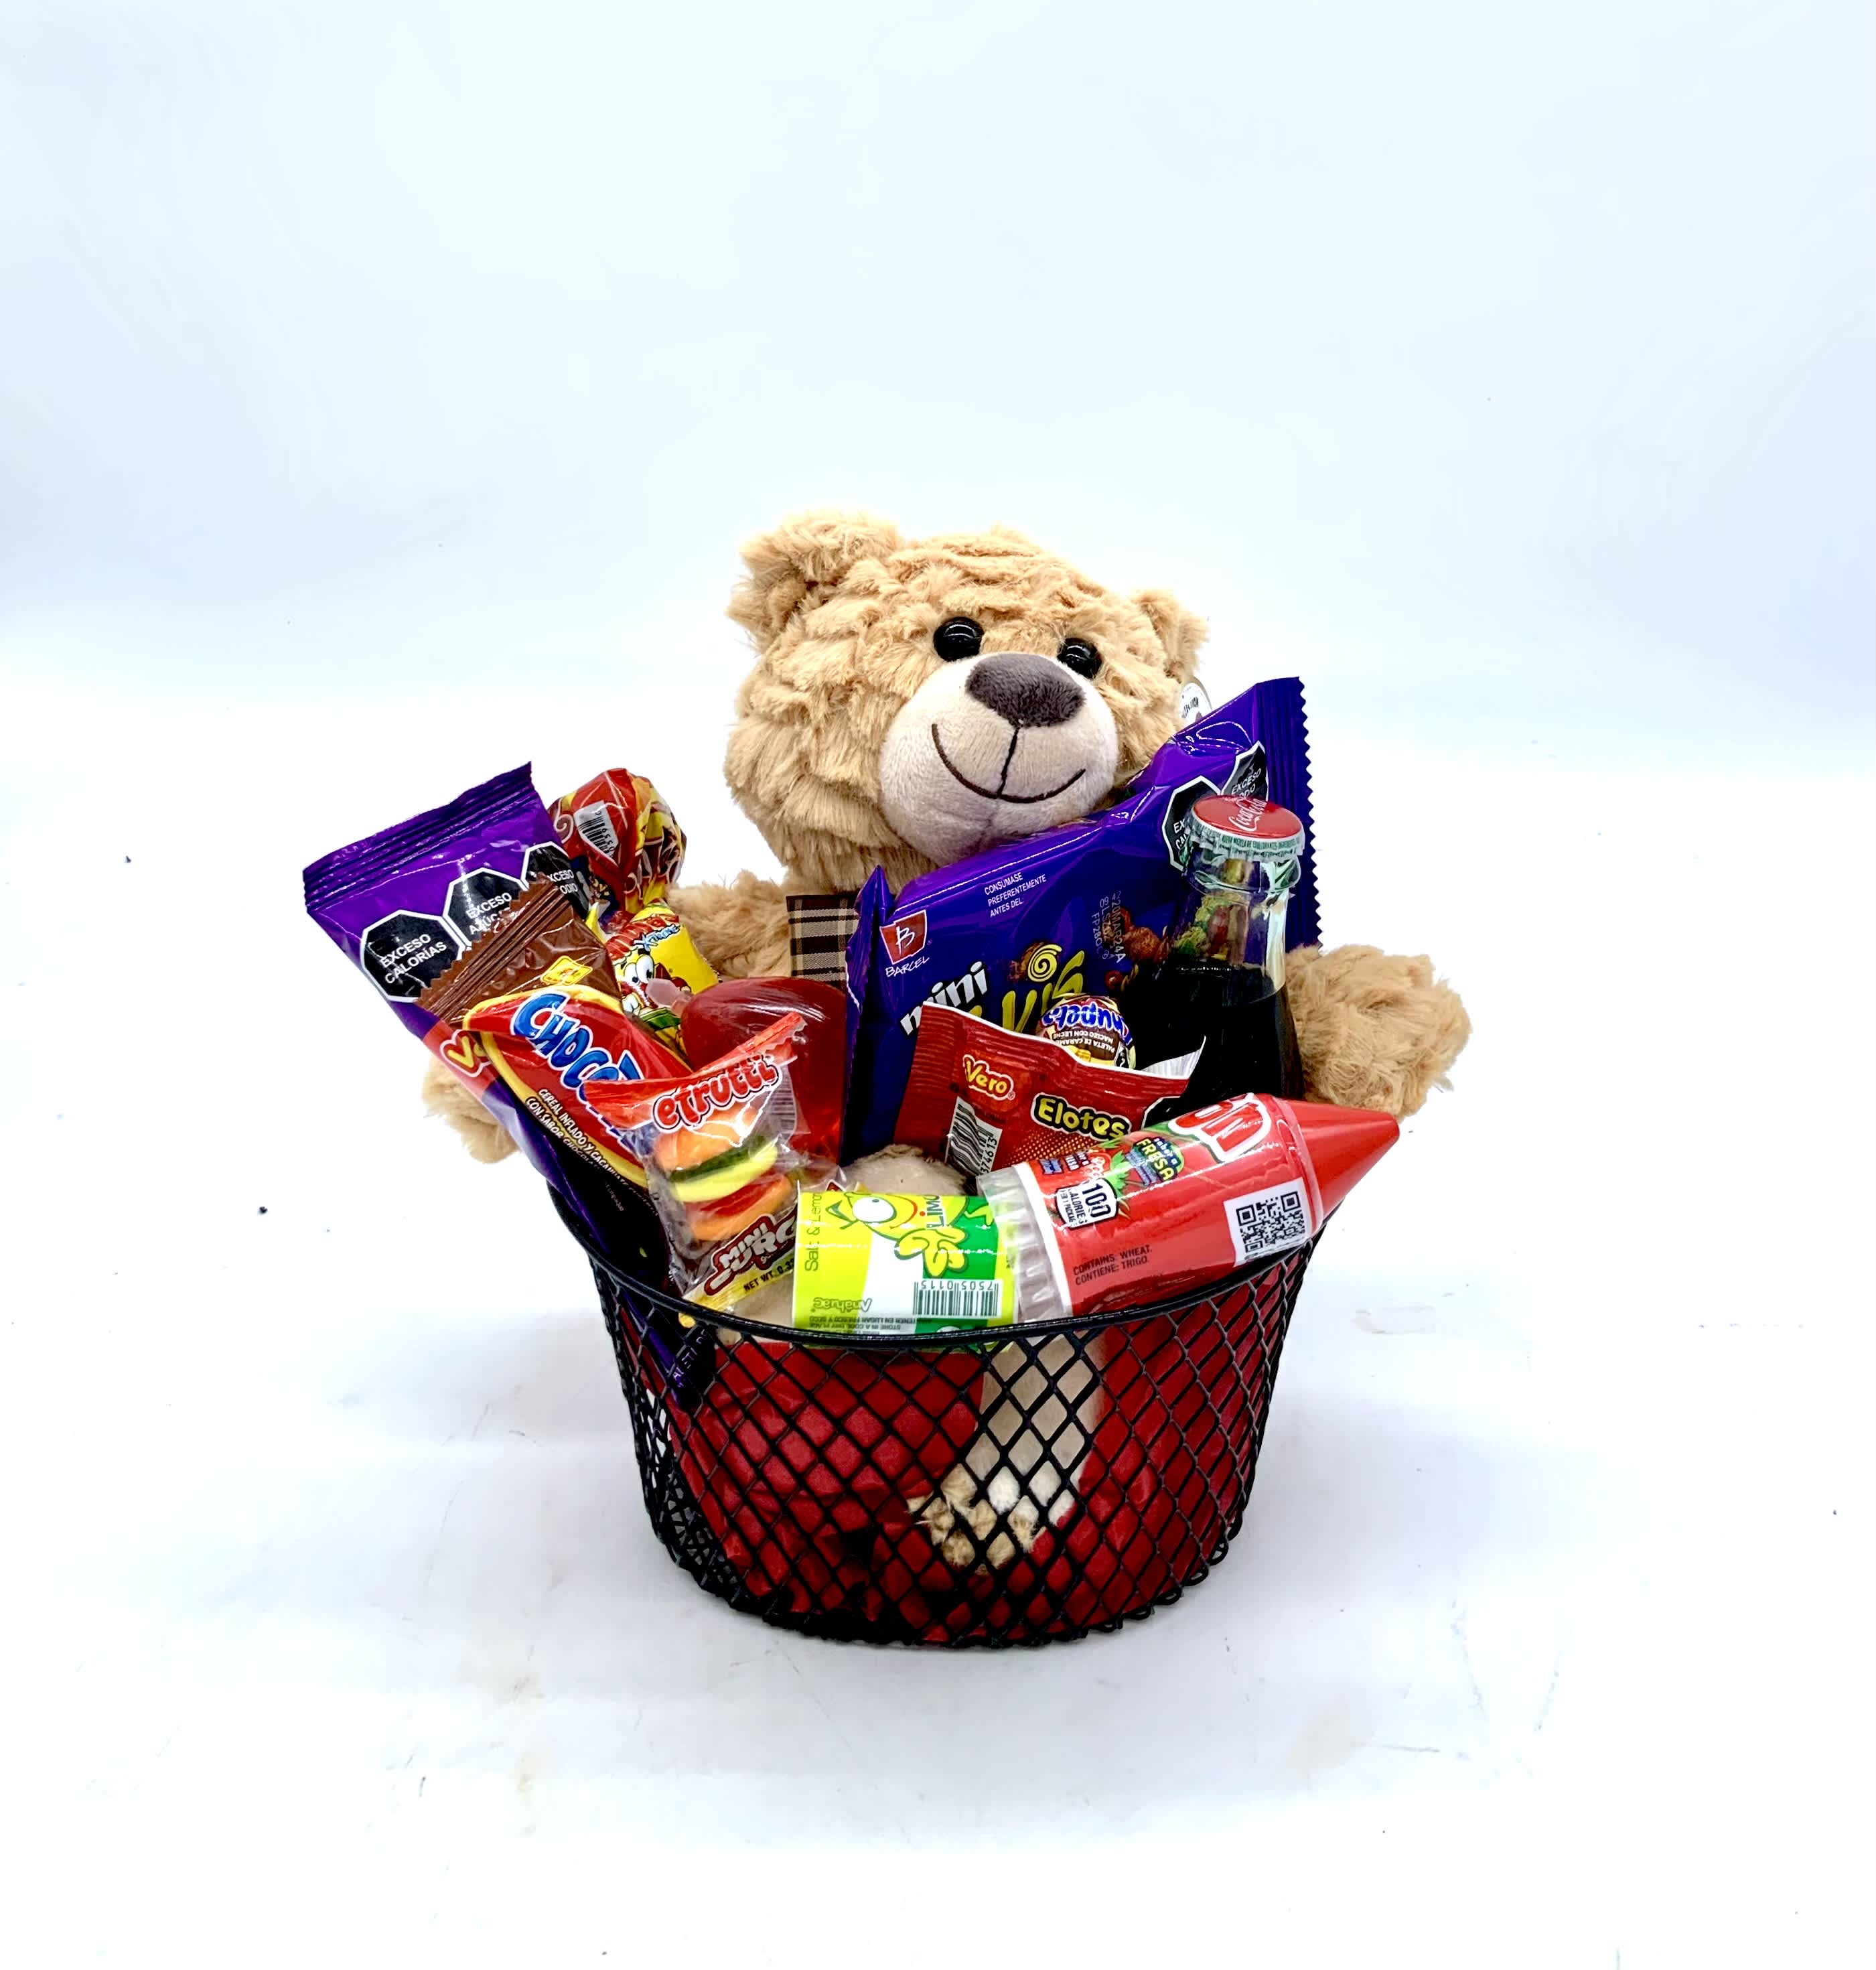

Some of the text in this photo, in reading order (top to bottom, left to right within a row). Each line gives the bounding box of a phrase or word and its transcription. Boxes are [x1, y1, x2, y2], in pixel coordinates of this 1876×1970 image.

[1231, 768, 1262, 794] EXCESO
[549, 868, 575, 883] XCESO
[984, 871, 1023, 896] CONSUMASE
[559, 882, 579, 896] ODIO
[987, 873, 1048, 906] PREFERENTEMENTE
[466, 892, 512, 920] EXCESO
[989, 904, 1010, 918] ANTES
[379, 933, 432, 969] EXCESO
[384, 940, 448, 985] CALORÍAS
[885, 955, 930, 978] BARCEL
[1092, 1039, 1115, 1054] PALETA
[965, 1058, 1008, 1095] Vero
[538, 1088, 564, 1117] CEREAL
[559, 1111, 587, 1147] INFLADO
[540, 1113, 565, 1139] SABOR
[1038, 1097, 1127, 1141] Elotes
[1137, 1137, 1175, 1181] FRESA
[1082, 1182, 1112, 1218] 100
[806, 1226, 820, 1236] &
[719, 1222, 769, 1269] MINI
[1119, 1244, 1153, 1260] WHEAT.
[743, 1277, 760, 1293] NET
[921, 1280, 994, 1291] 7505 0115
[1075, 1263, 1120, 1286] CONTIENE:
[812, 1297, 873, 1313] Anáhuac
